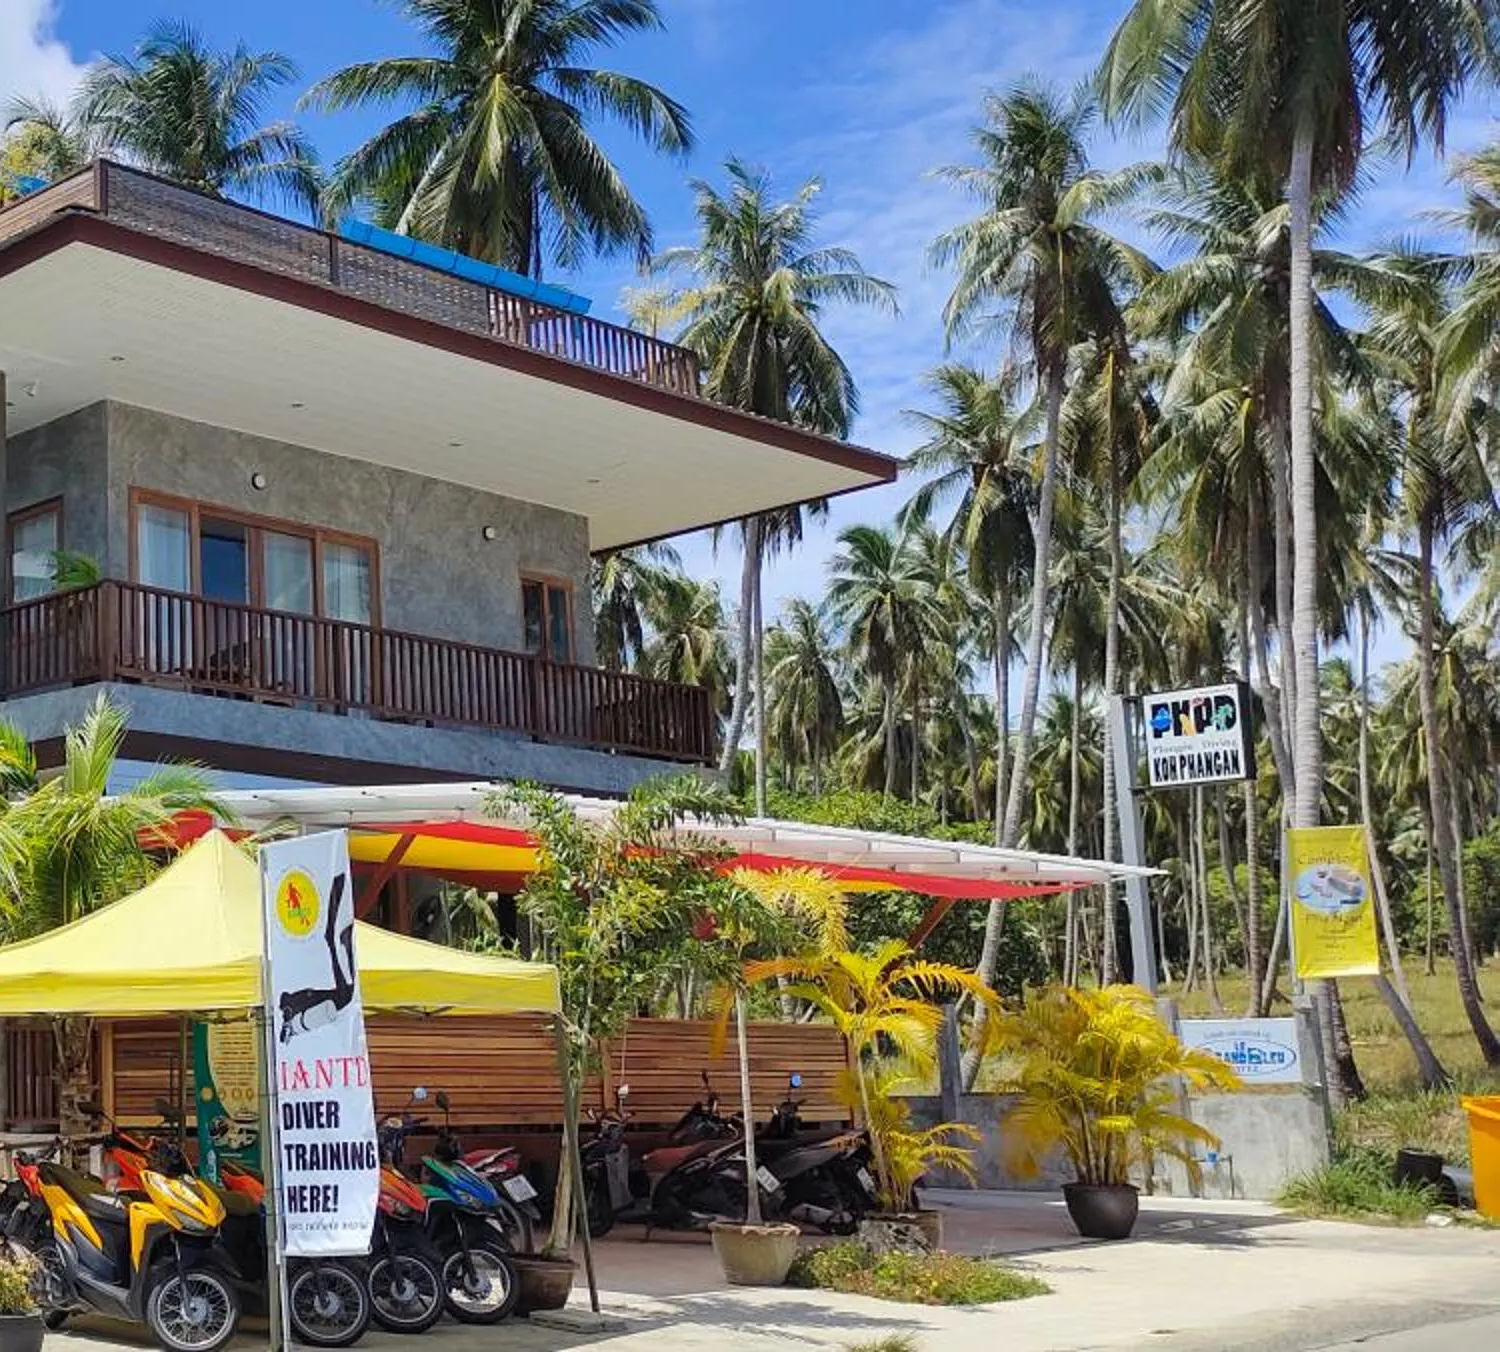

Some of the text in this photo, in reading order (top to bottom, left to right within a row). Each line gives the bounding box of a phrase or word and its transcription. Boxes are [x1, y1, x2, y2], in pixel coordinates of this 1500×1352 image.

[1154, 749, 1241, 782] KOH PHANGAN
[280, 1056, 370, 1090] IANTD
[282, 1101, 340, 1131] DIVER
[284, 1141, 377, 1171] TRAINING
[287, 1185, 339, 1214] HERE!
